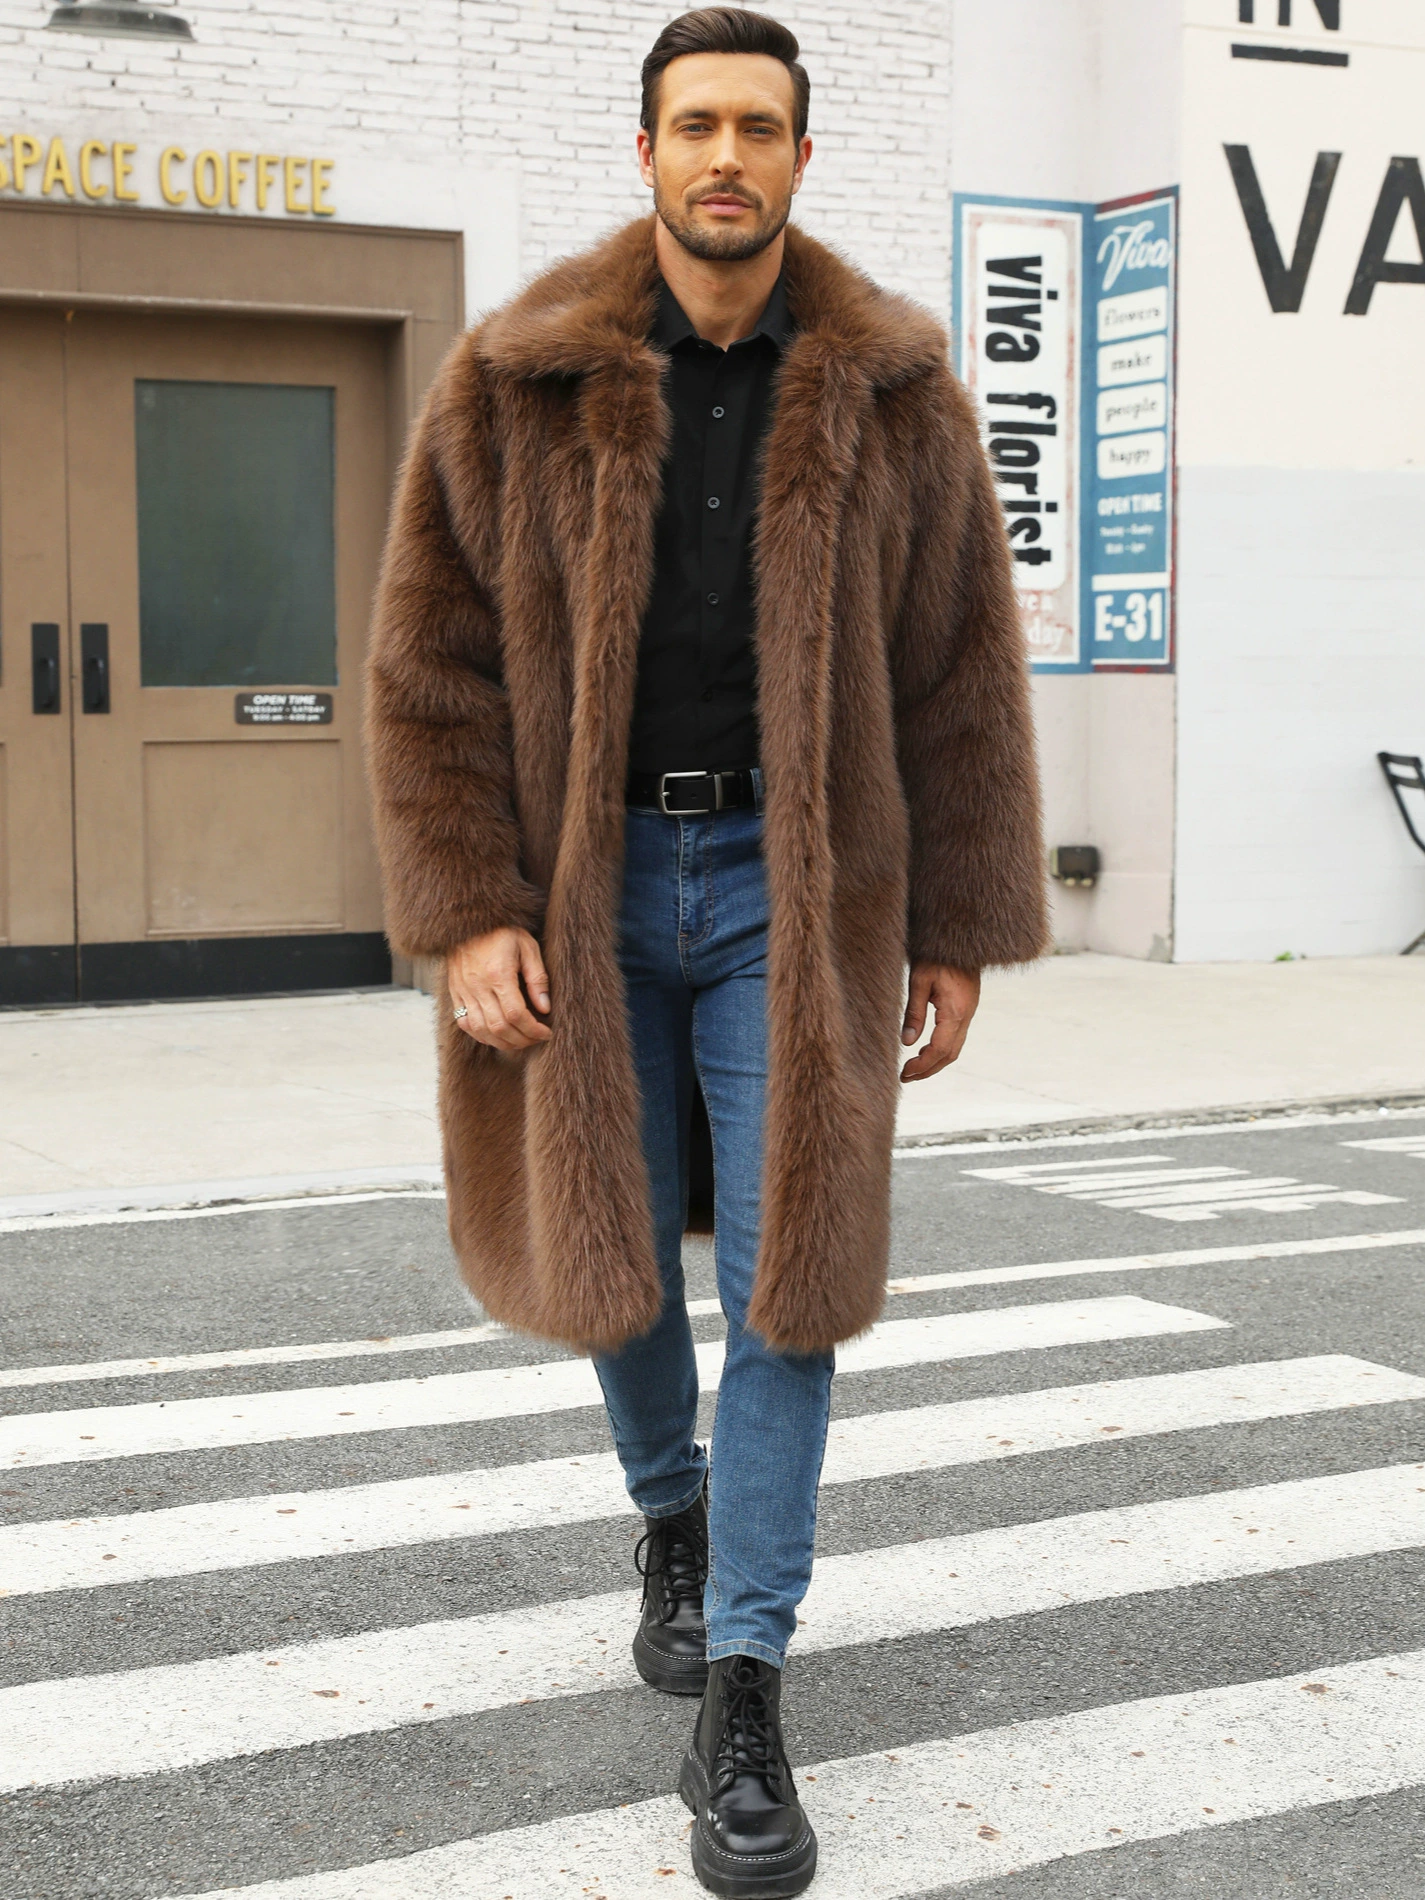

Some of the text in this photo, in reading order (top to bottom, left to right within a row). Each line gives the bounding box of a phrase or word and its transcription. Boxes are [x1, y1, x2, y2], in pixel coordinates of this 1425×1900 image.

[159, 146, 336, 216] COFFEE
[1222, 142, 1425, 316] VA
[1097, 220, 1169, 291] Viva
[985, 255, 1058, 363] viva
[1111, 351, 1152, 372] make
[1105, 396, 1158, 422] people
[986, 392, 1058, 566] florist
[1109, 448, 1151, 465] happy
[1098, 492, 1163, 516] OPEN TIME
[1094, 592, 1163, 642] E-31
[253, 694, 317, 706] OPEN TIME
